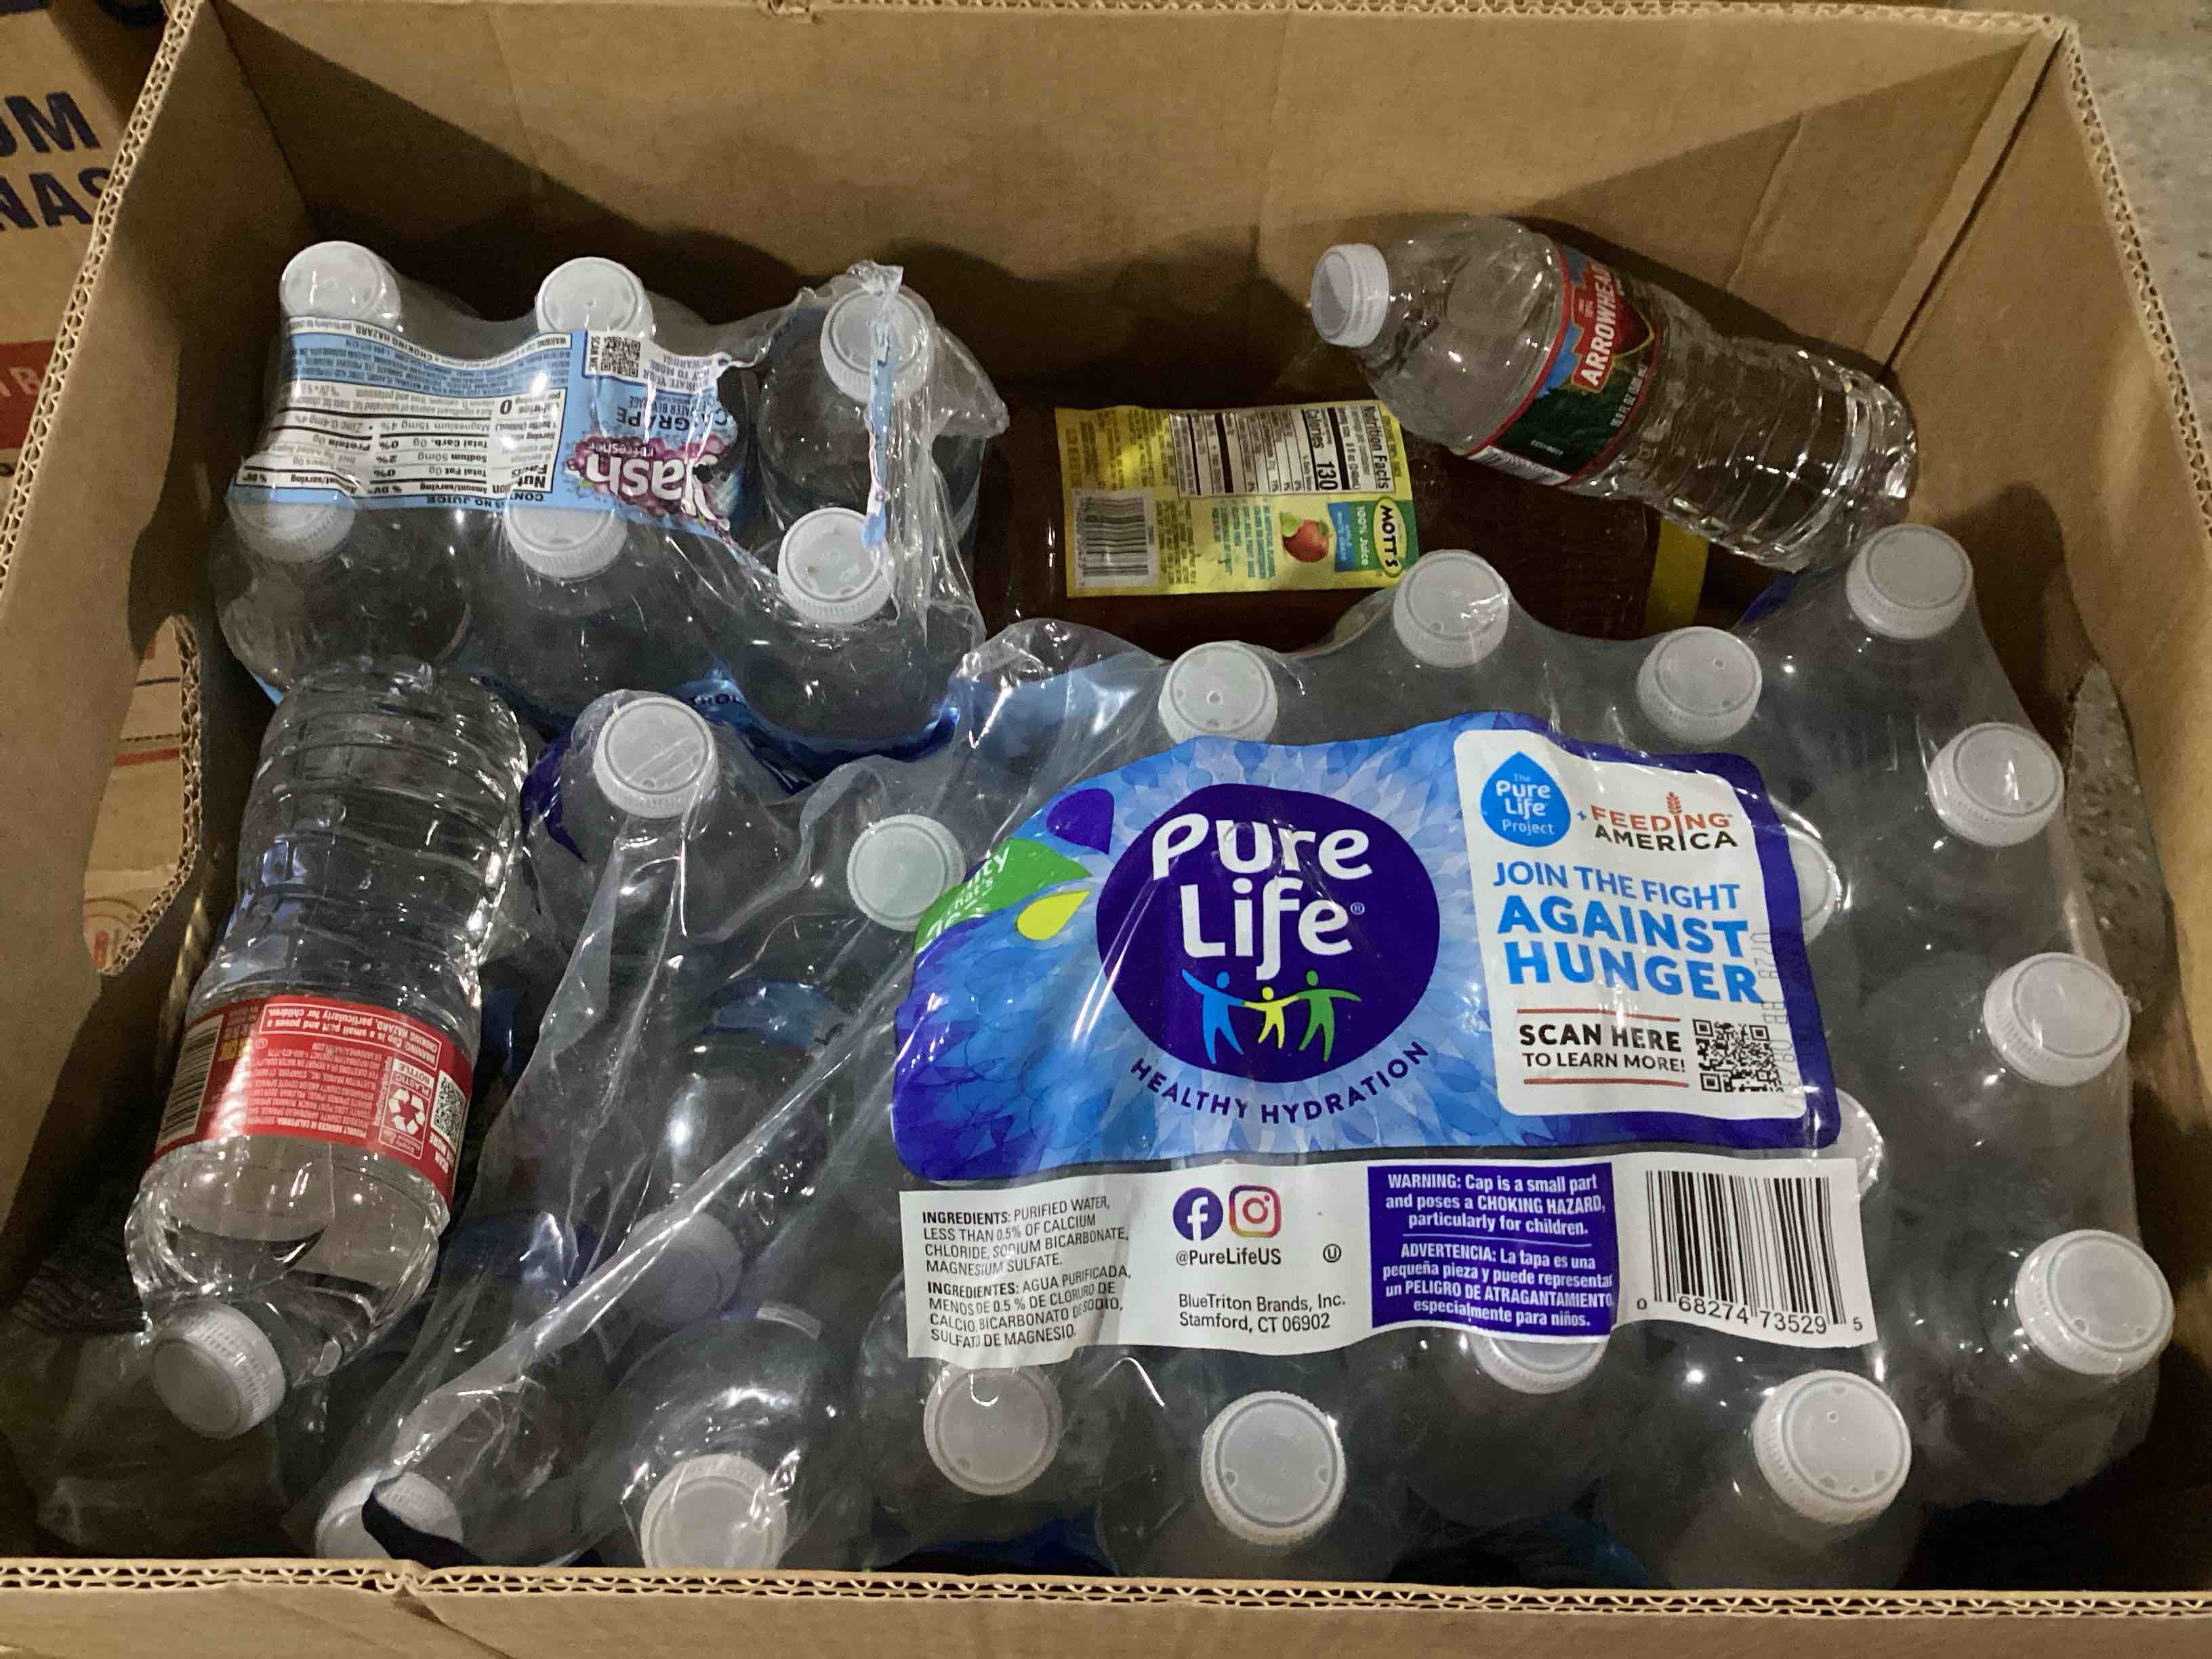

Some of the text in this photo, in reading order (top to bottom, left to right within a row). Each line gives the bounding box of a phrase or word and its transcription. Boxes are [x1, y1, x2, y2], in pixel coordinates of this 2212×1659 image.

[1580, 260, 1617, 386] ARROWHEA
[434, 423, 489, 431] Magnesium
[329, 438, 371, 451] Protein
[451, 454, 487, 462] Sodium
[464, 469, 487, 477] Total
[1316, 461, 1338, 490] 130
[1373, 455, 1391, 489] Facts
[1360, 536, 1370, 565] Juice
[1496, 780, 1551, 799] Pure
[1513, 773, 1530, 782] The
[1504, 797, 1547, 820] Life
[1591, 804, 1730, 834] FEEDING
[1502, 819, 1555, 836] Project
[1595, 824, 1738, 852] AMERICA
[1152, 813, 1372, 881] Pure
[1493, 861, 1740, 912] JOIN THE FIGHT
[1179, 876, 1353, 981] Life
[1496, 895, 1749, 958] AGAINST
[1504, 941, 1763, 1004] HUNGER
[303, 1020, 321, 1029] and
[307, 1010, 320, 1019] for
[343, 1025, 367, 1037] small
[378, 1032, 385, 1042] is
[388, 1035, 402, 1048] Cap
[1519, 1023, 1682, 1052] SCAN HERE
[1525, 1052, 1686, 1073] TO LEARN MORE!
[1130, 1040, 1429, 1124] HEALTHY HYDRATION
[1388, 1173, 1598, 1195] WARNING: Cap is a small part
[922, 1195, 1110, 1225] INGREDIENTS: PURIFIED WATER,
[1385, 1193, 1605, 1215] and poses a CHOKING HAZARD,
[924, 1214, 1097, 1242] LESS THAN 0.5% OF CALCIUM
[1408, 1212, 1589, 1236] particularly for children.
[925, 1227, 1129, 1260] CHLORIDE, SODIUM BICARBONATE,
[1176, 1248, 1282, 1266] @PureLifeUS
[1401, 1243, 1596, 1270] ADVERTENCIA: La tapa es una
[926, 1254, 1063, 1276] MAGNESIUM SULFATE.
[1383, 1262, 1613, 1289] pequeña pieza y puede representar
[928, 1265, 1132, 1298] INGREDIENTES: AGUA PURIFICADA,
[1386, 1280, 1613, 1308] un PELIGRO DE ATRAGANTAMIENTO
[929, 1282, 1115, 1315] MENOS DE 0.5 % DE CLORURO DE
[1179, 1293, 1346, 1312] BlueTriton Brands, Inc.
[930, 1313, 977, 1332] CALCIO,
[980, 1307, 1069, 1330] BICARBONATO
[1082, 1296, 1123, 1313] SODIO,
[1180, 1312, 1330, 1334] Stamford, CT 06902
[1414, 1300, 1591, 1327] especialmente para niños.
[1636, 1296, 1864, 1334] 0 68274 73529 5
[984, 1333, 1000, 1347] DE
[1004, 1324, 1076, 1345] MAGNESIO.
